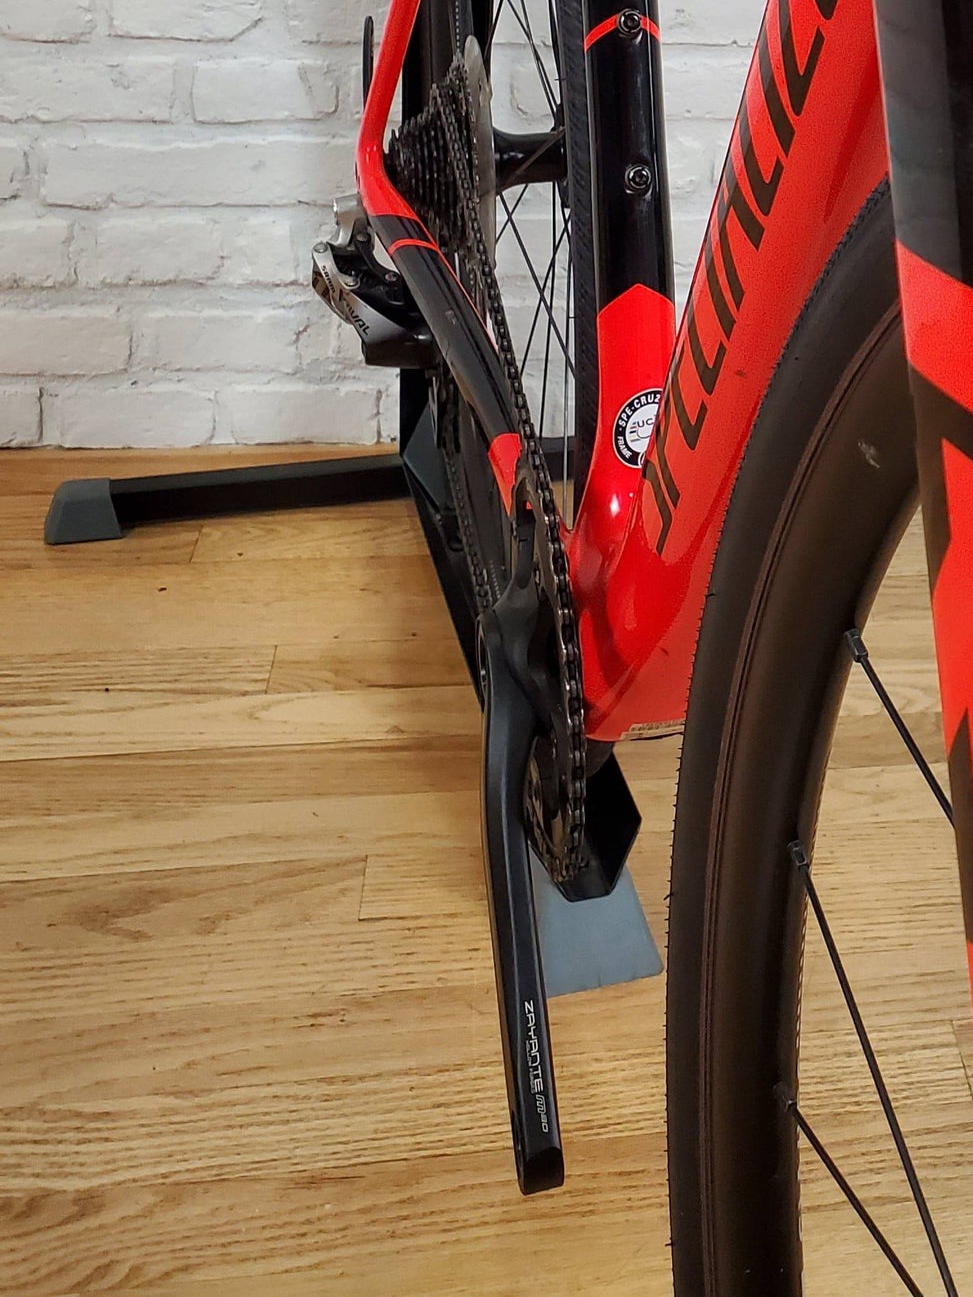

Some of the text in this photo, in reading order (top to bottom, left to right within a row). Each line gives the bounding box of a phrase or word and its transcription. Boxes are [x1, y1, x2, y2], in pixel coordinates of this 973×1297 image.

[321, 265, 336, 294] SRAM
[617, 436, 632, 459] FRAME
[525, 1000, 543, 1092] ZAYANTE
